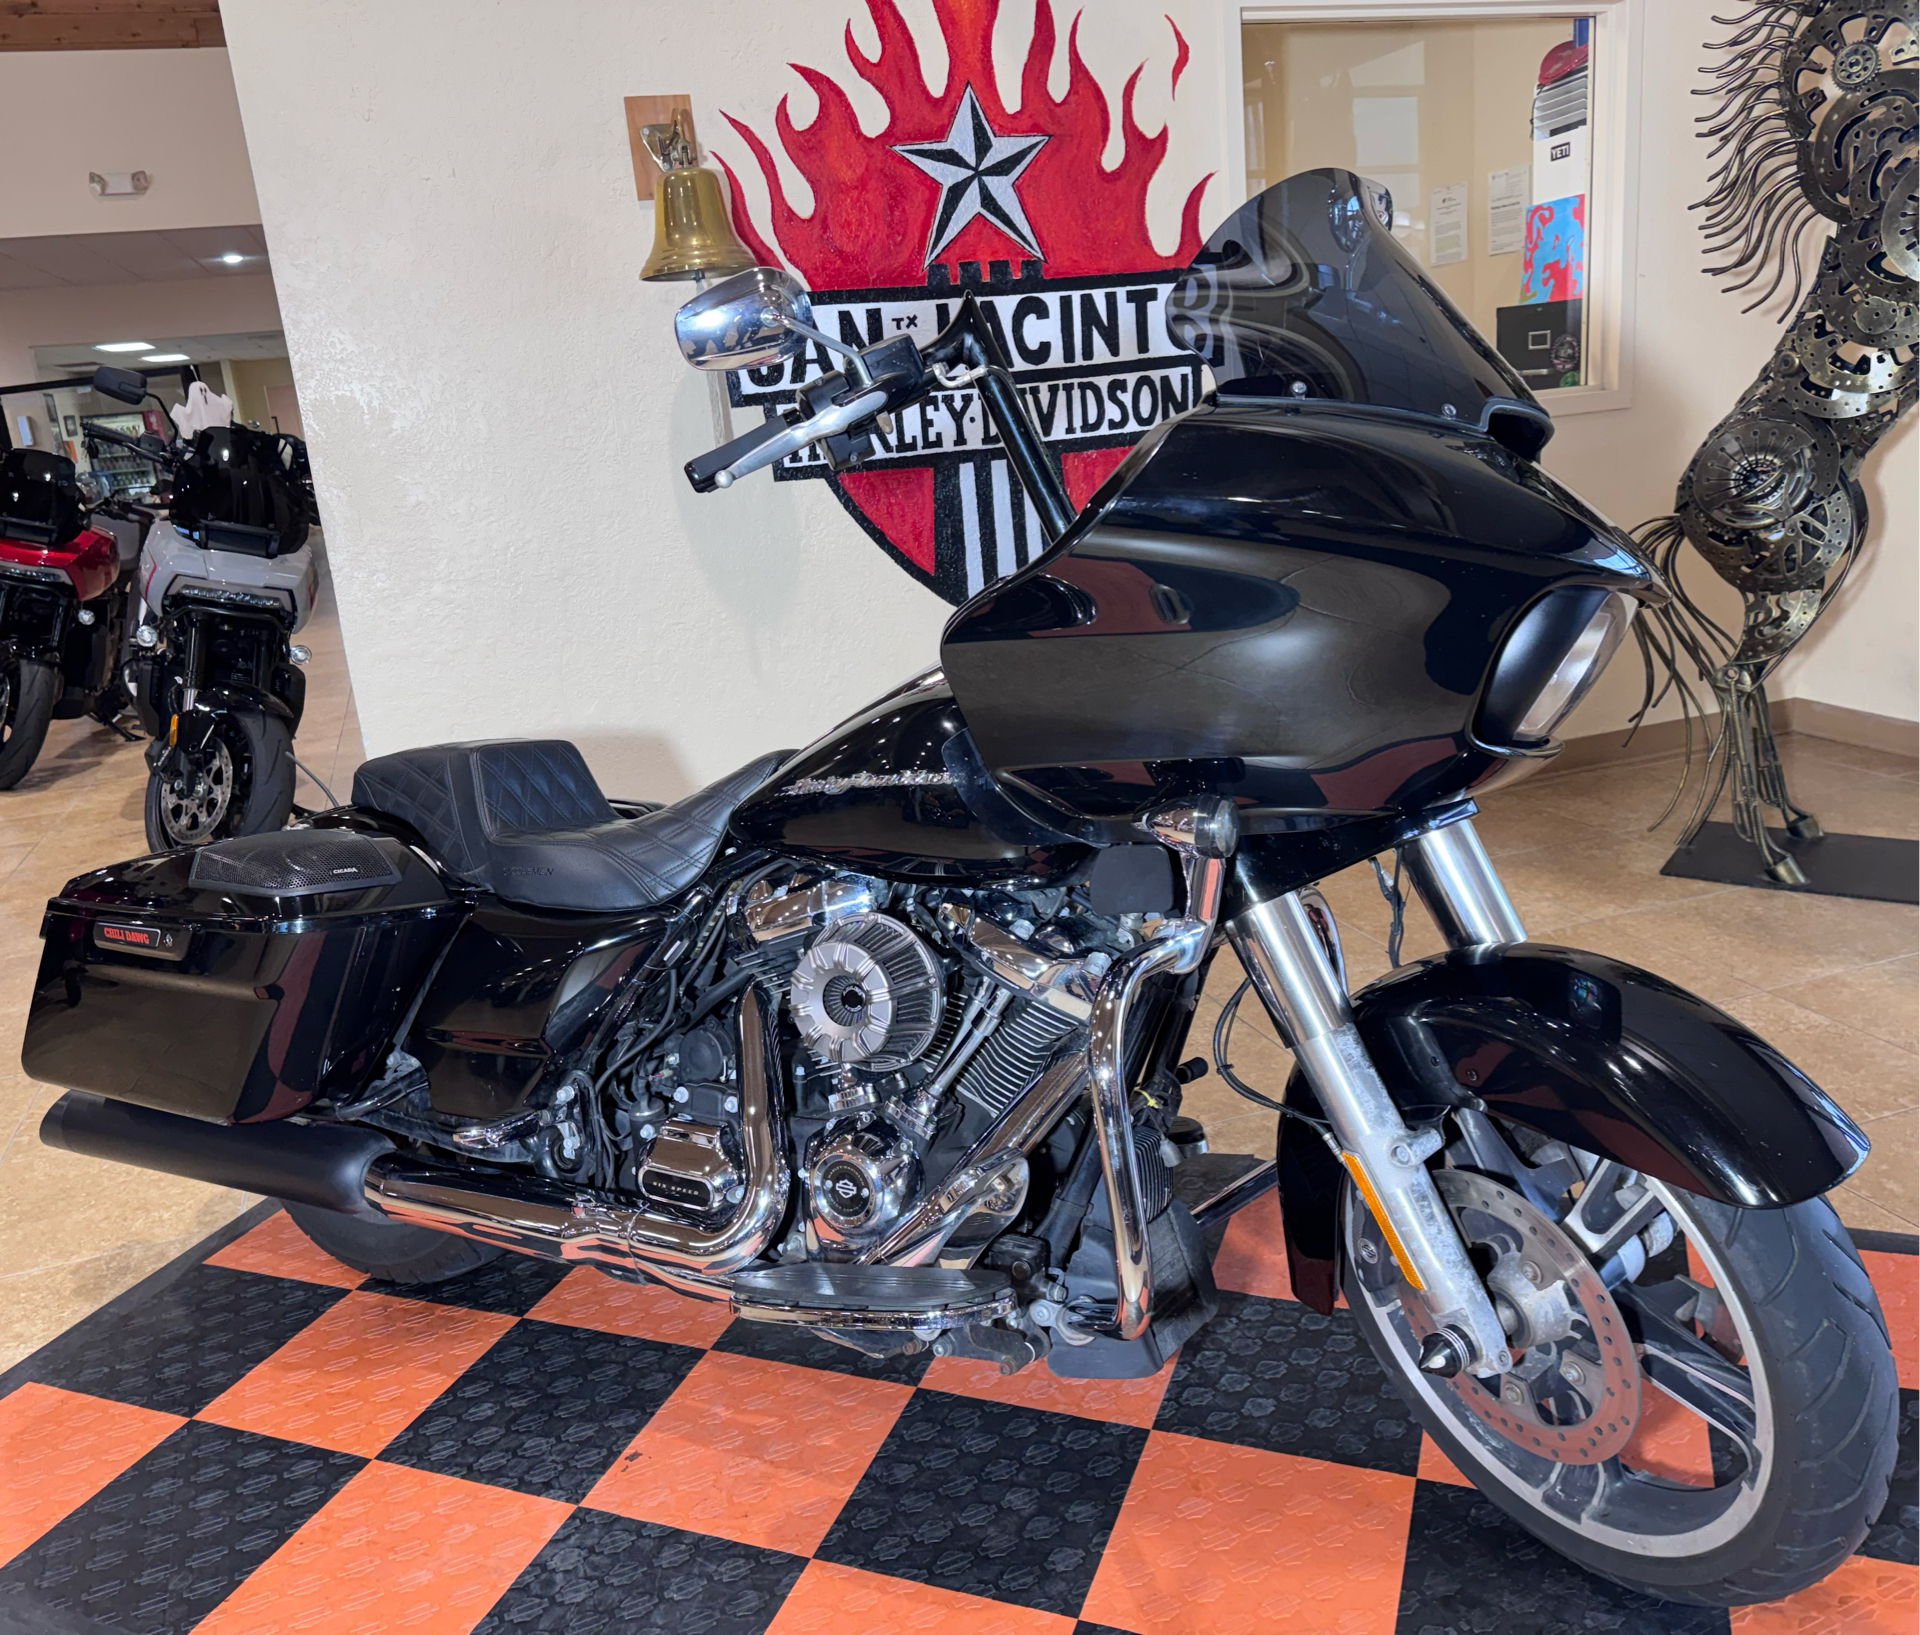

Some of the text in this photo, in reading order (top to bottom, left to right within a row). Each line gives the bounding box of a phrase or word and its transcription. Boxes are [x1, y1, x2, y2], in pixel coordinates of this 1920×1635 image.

[1551, 145, 1570, 160] YETI
[747, 287, 1200, 388] AN TX ACINT
[103, 927, 150, 945] CHILI DAWG
[652, 1181, 699, 1196] SIX SPEED
